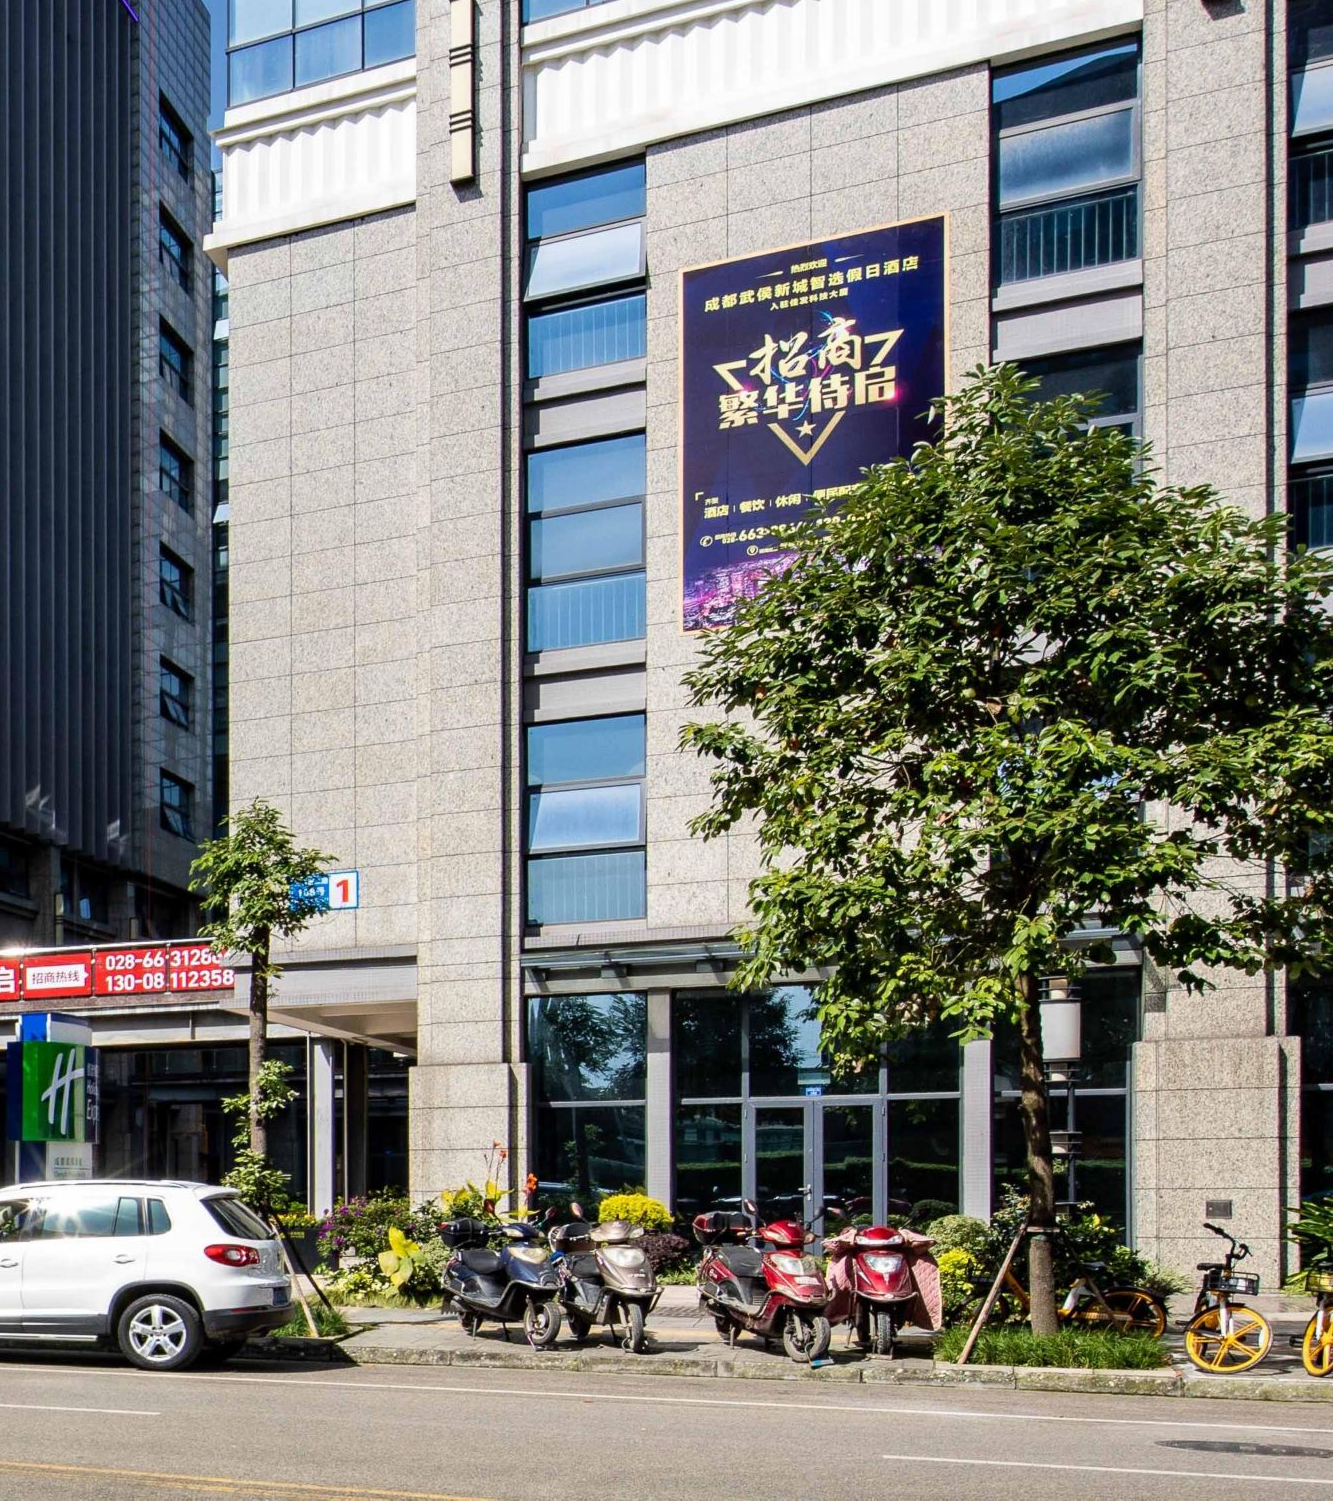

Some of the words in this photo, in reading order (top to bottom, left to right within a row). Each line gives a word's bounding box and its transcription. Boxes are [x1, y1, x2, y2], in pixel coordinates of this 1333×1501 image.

[704, 255, 919, 312] 成都武侯新城智选假日酒店
[748, 316, 862, 384] 招商
[718, 365, 897, 430] 繁华待启
[703, 504, 730, 519] 酒店
[336, 879, 349, 902] 1
[32, 970, 81, 985] 招商热线
